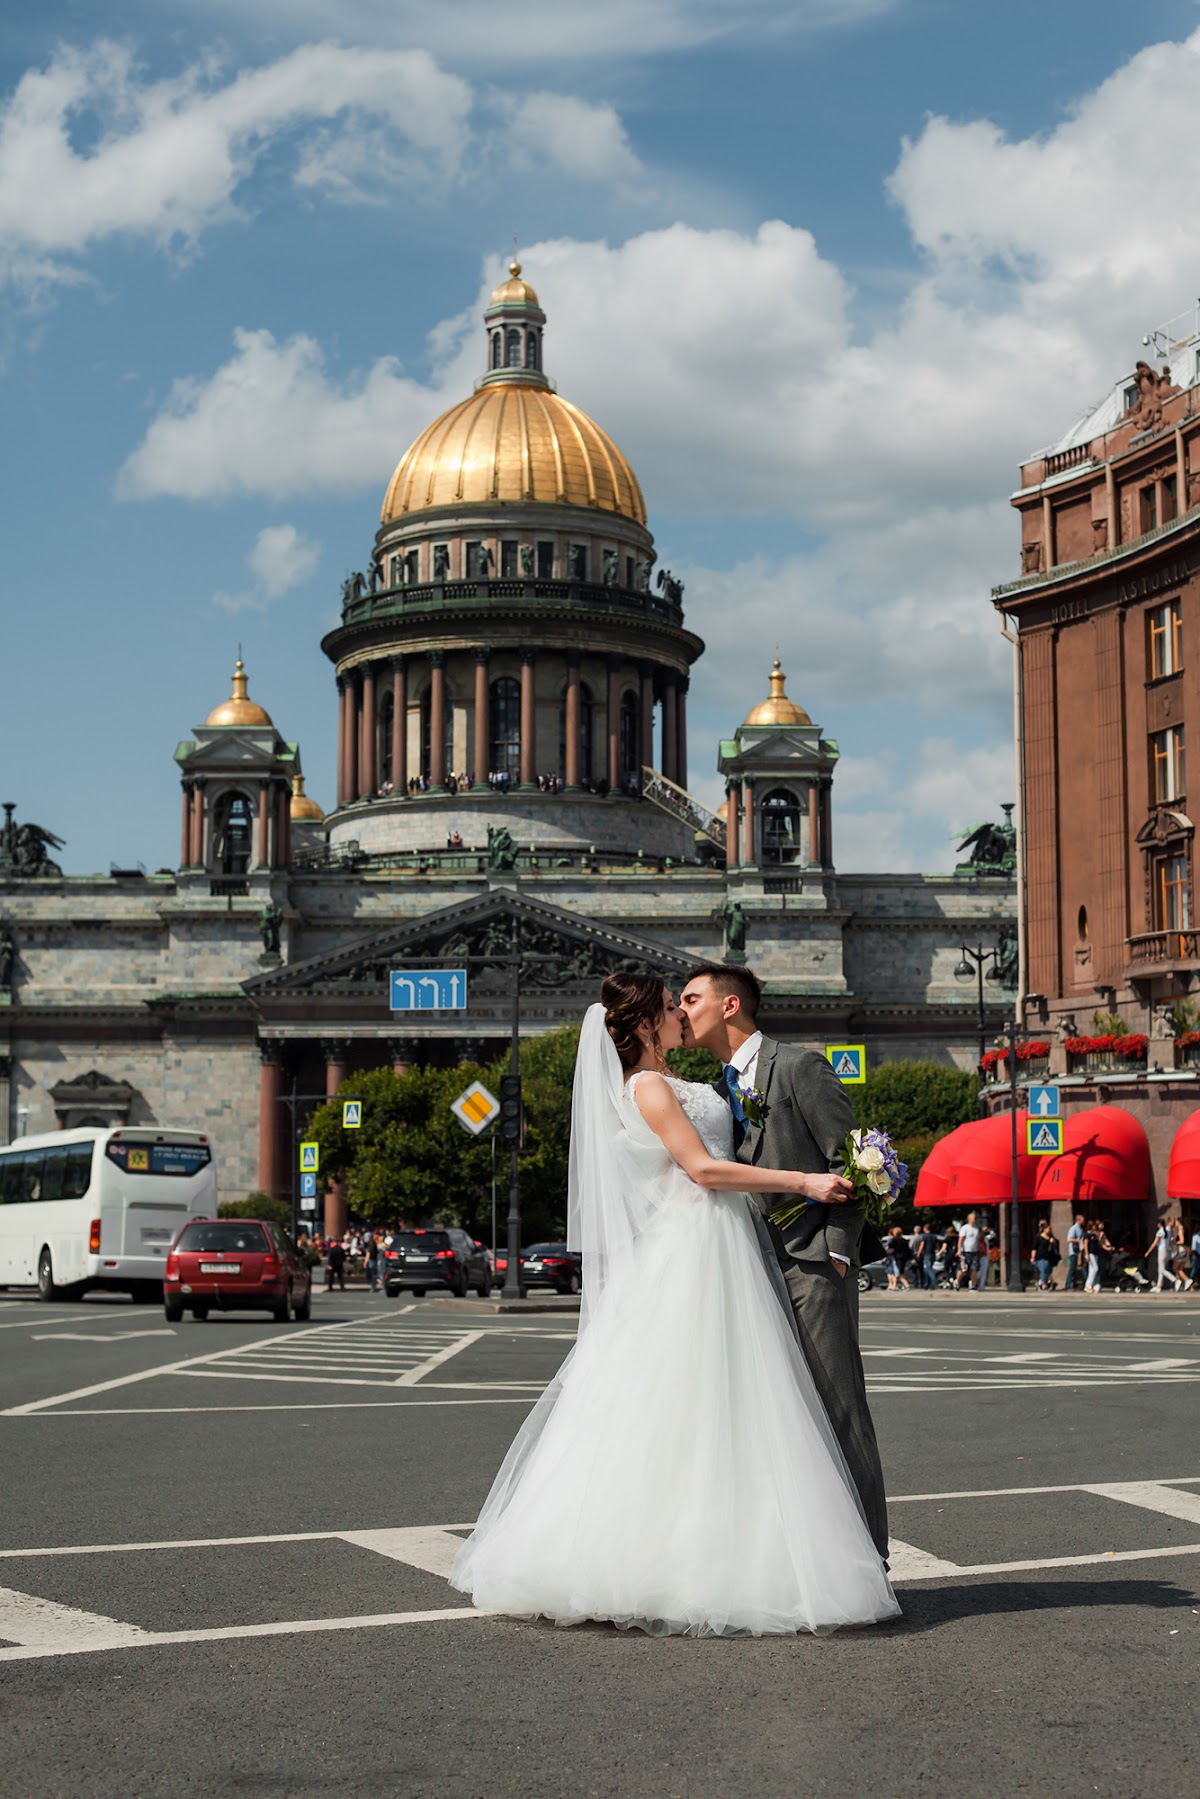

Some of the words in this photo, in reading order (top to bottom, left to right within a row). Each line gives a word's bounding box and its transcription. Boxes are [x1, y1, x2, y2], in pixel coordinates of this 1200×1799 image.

[1051, 596, 1089, 624] HOTEL
[1119, 560, 1190, 603] ASTORIA
[304, 1176, 313, 1193] P
